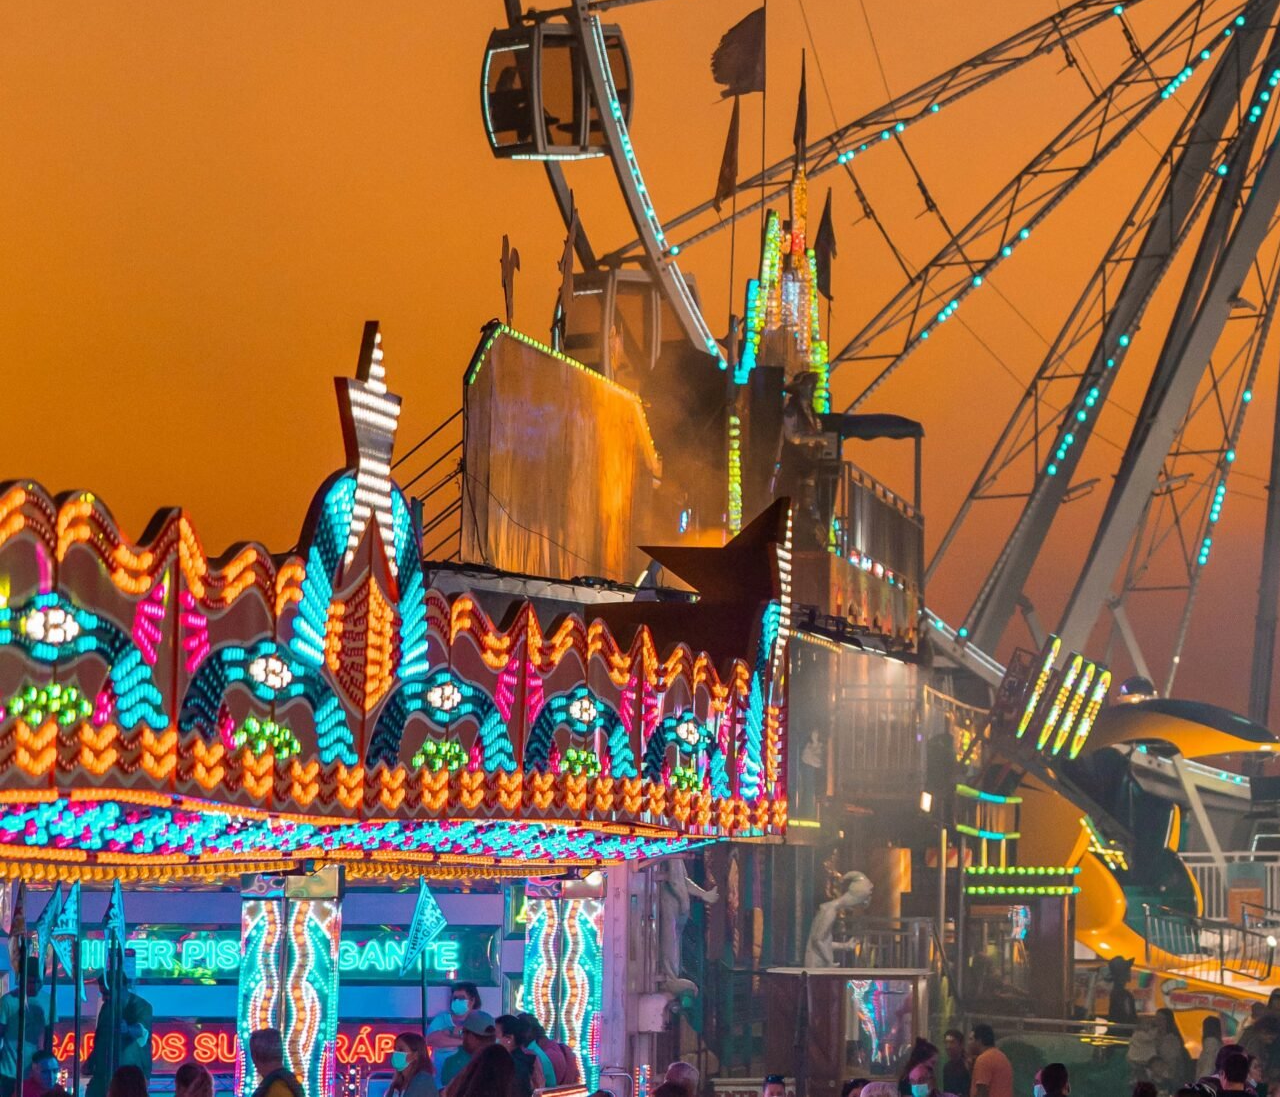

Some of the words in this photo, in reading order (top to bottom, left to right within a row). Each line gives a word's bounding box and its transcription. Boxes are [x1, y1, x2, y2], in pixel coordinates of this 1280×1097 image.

[422, 915, 443, 937] GIGA
[182, 939, 240, 970] PIS
[338, 940, 459, 971] GANTE
